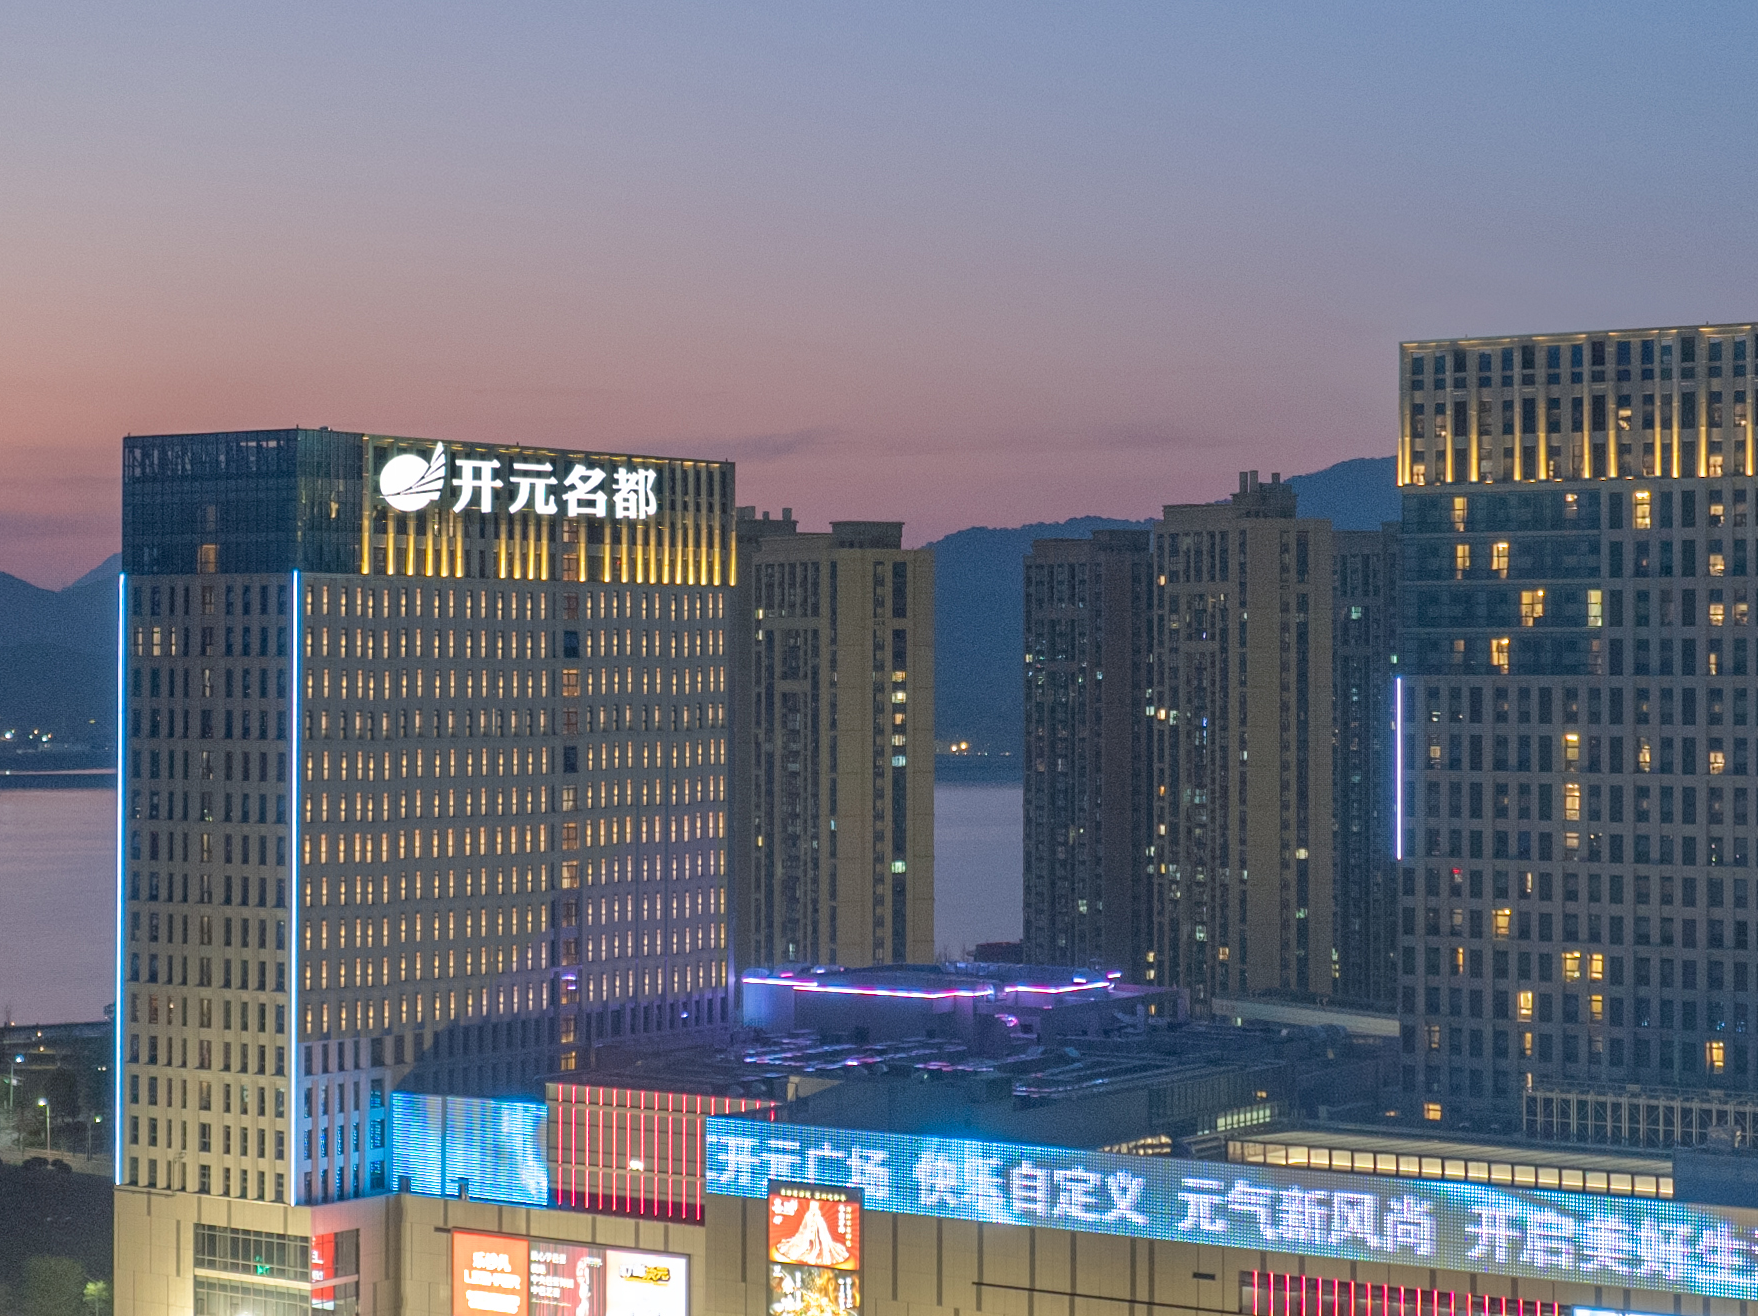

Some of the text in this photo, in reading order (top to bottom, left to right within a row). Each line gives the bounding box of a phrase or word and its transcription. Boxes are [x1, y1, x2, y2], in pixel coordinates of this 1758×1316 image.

[452, 457, 658, 519] 开元名都
[1176, 1177, 1438, 1257] 元气新风尚
